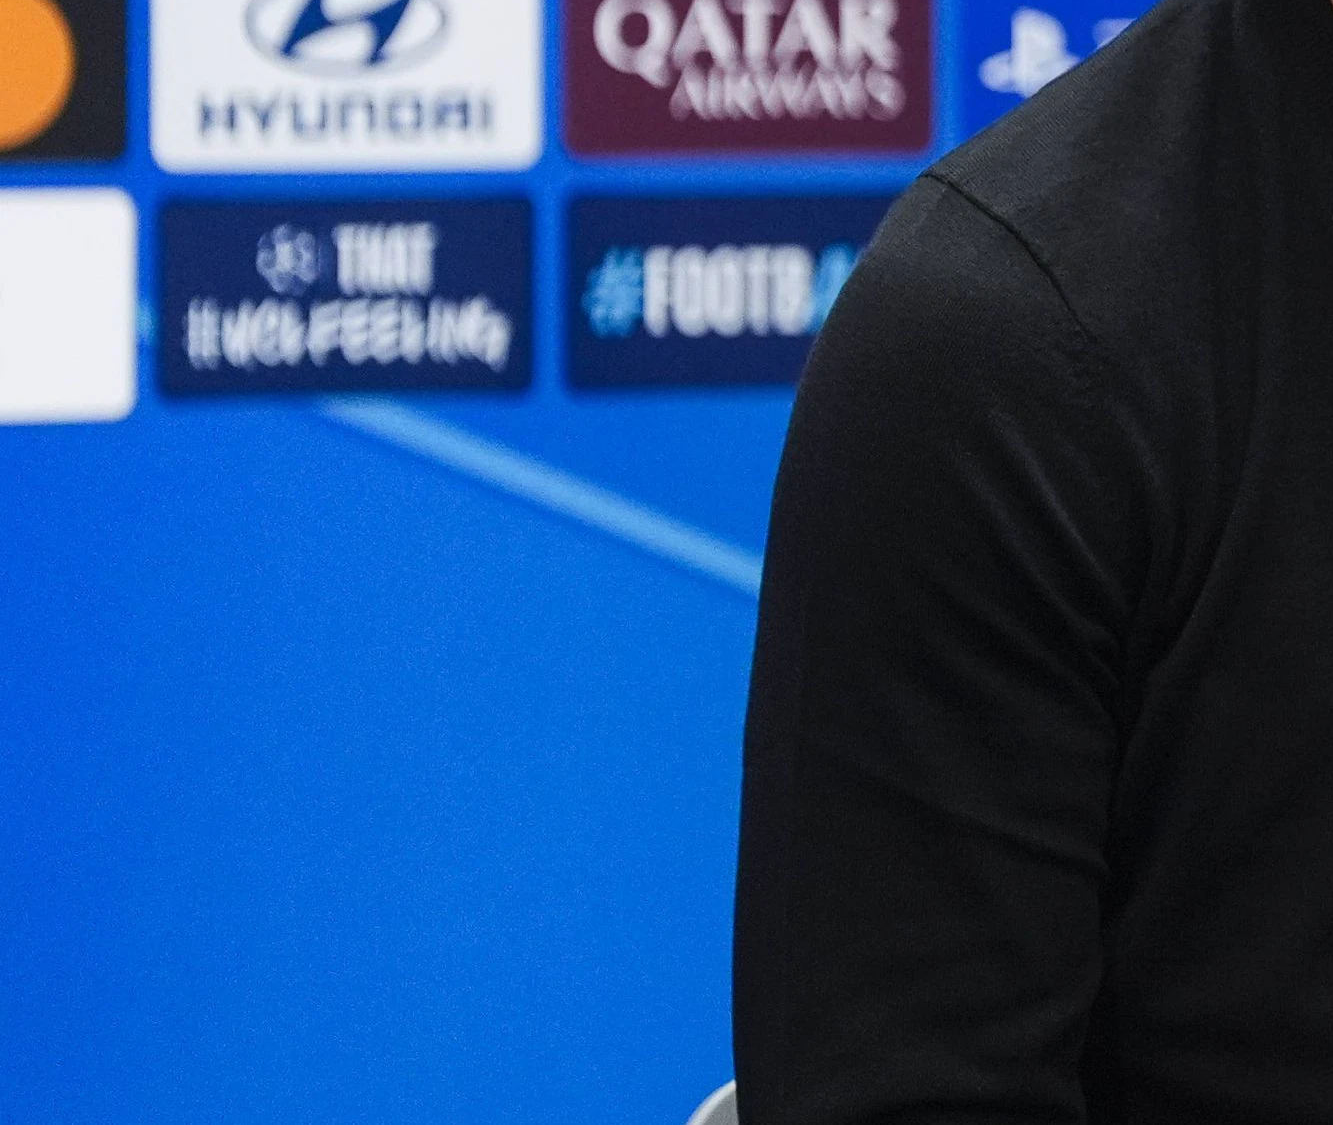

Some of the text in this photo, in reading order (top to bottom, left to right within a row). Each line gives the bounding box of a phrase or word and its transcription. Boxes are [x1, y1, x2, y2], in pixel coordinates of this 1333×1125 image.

[198, 90, 497, 143] HYUNDAI
[669, 68, 904, 121] AIRWAYS
[581, 243, 858, 338] #FOOTBA
